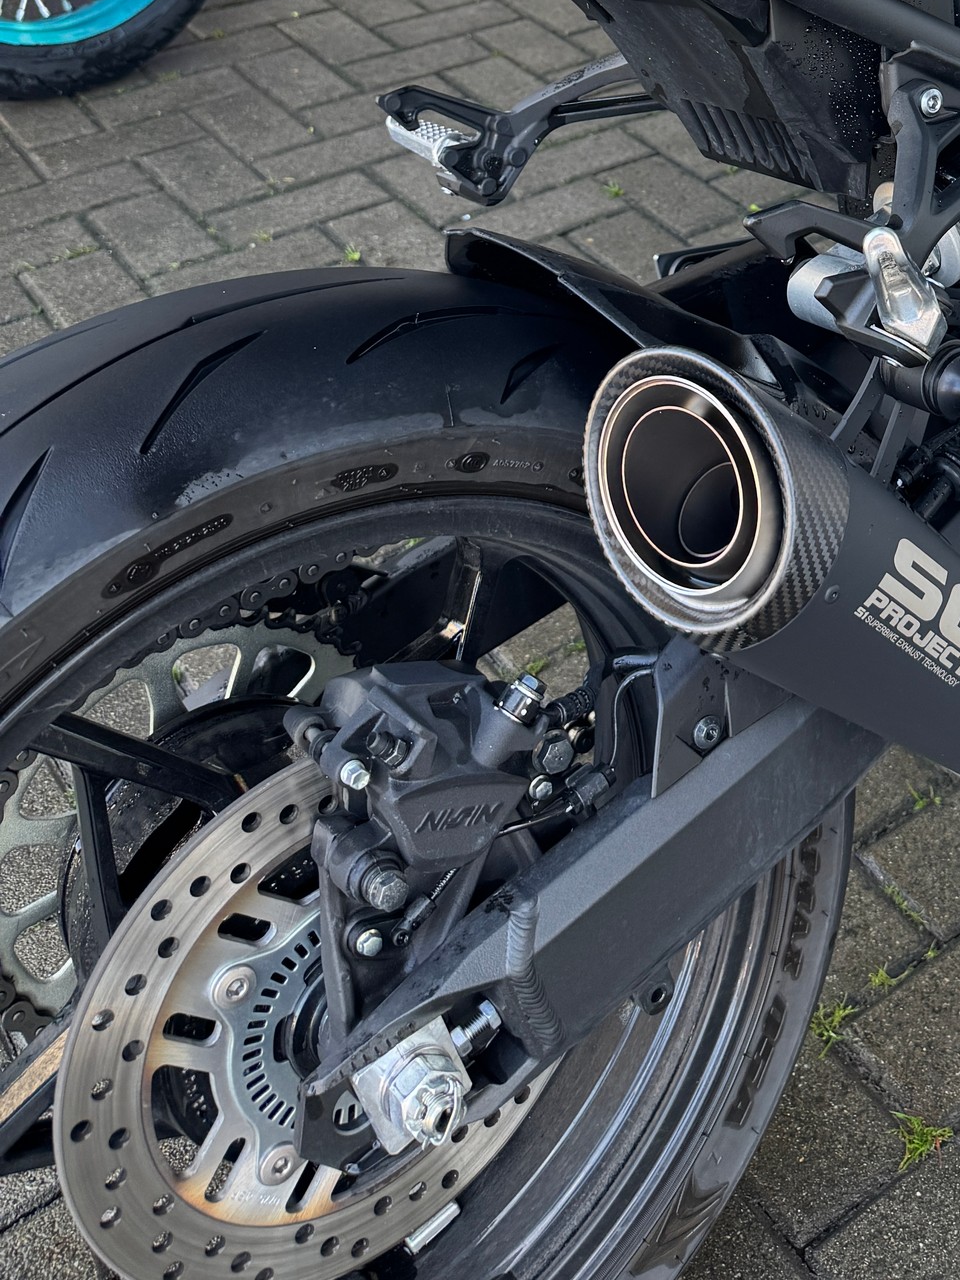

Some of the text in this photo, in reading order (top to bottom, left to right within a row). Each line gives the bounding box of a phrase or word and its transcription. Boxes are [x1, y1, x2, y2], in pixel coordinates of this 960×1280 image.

[854, 606, 960, 687] S1 SUPERBIKE EXHAUST TECHNOLOGY
